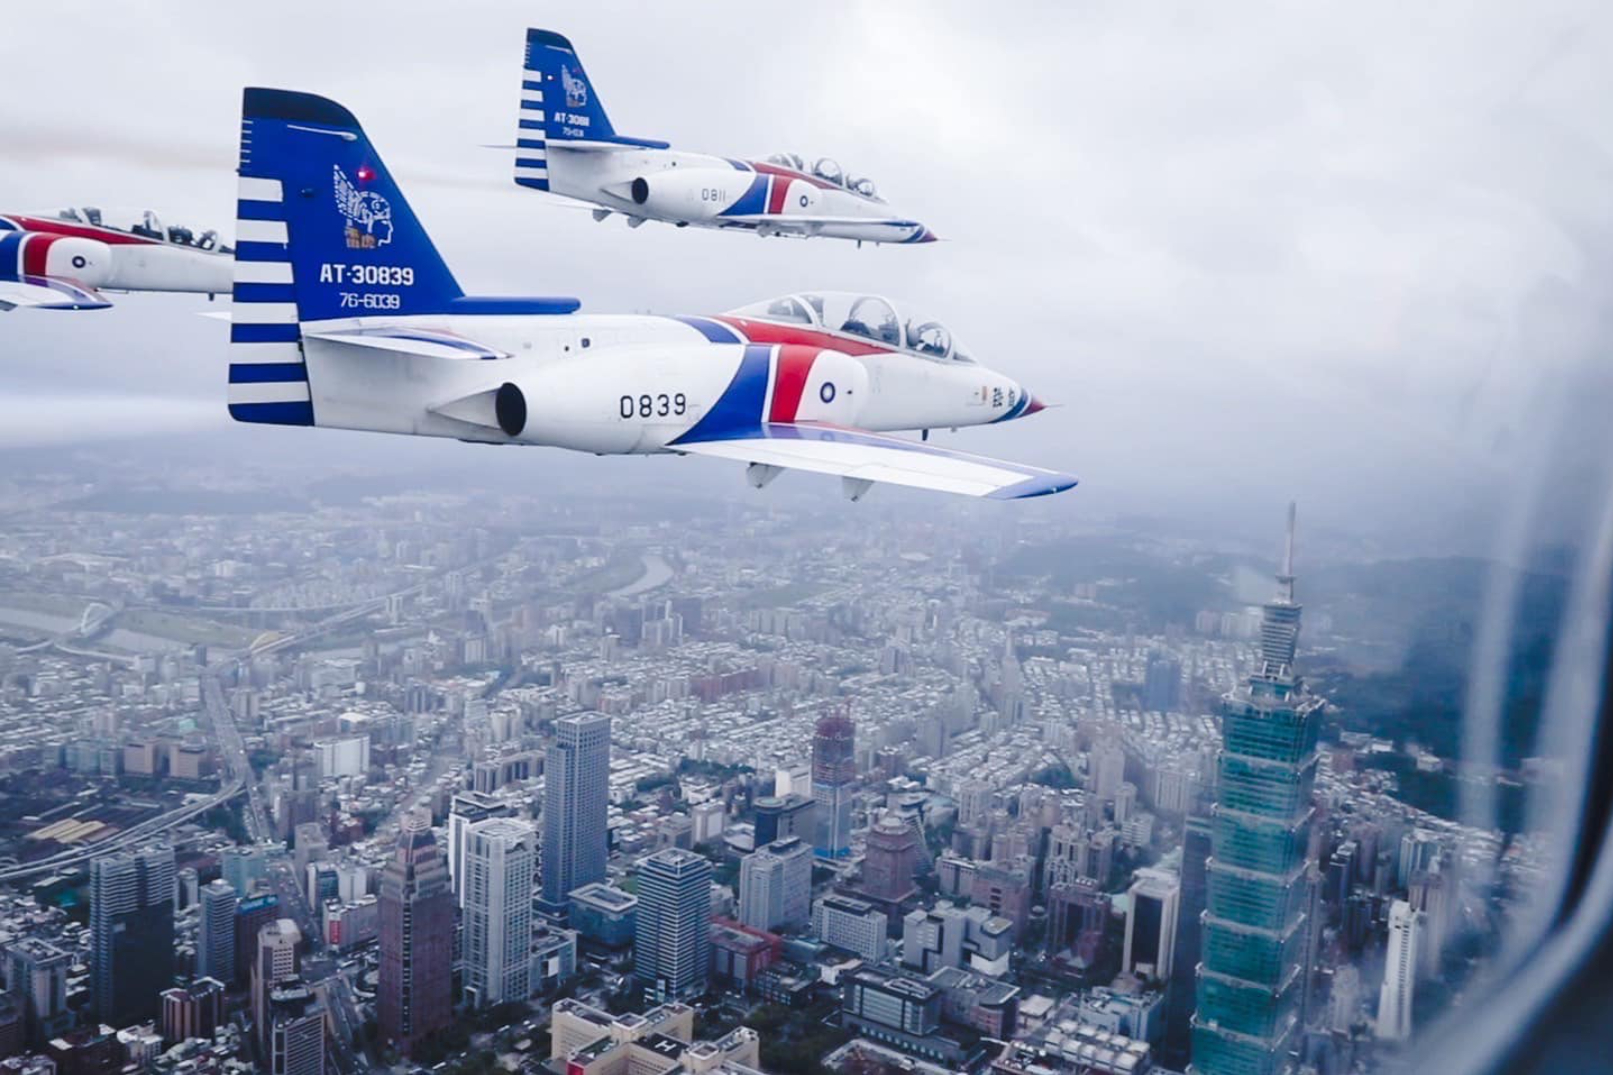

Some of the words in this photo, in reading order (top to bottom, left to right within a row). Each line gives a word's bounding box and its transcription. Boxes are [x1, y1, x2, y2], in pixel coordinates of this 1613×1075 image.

[702, 188, 726, 202] 0811
[319, 263, 414, 286] AT-30839
[339, 292, 400, 309] 76-6039
[620, 393, 686, 419] 0839
[654, 1040, 677, 1052] H
